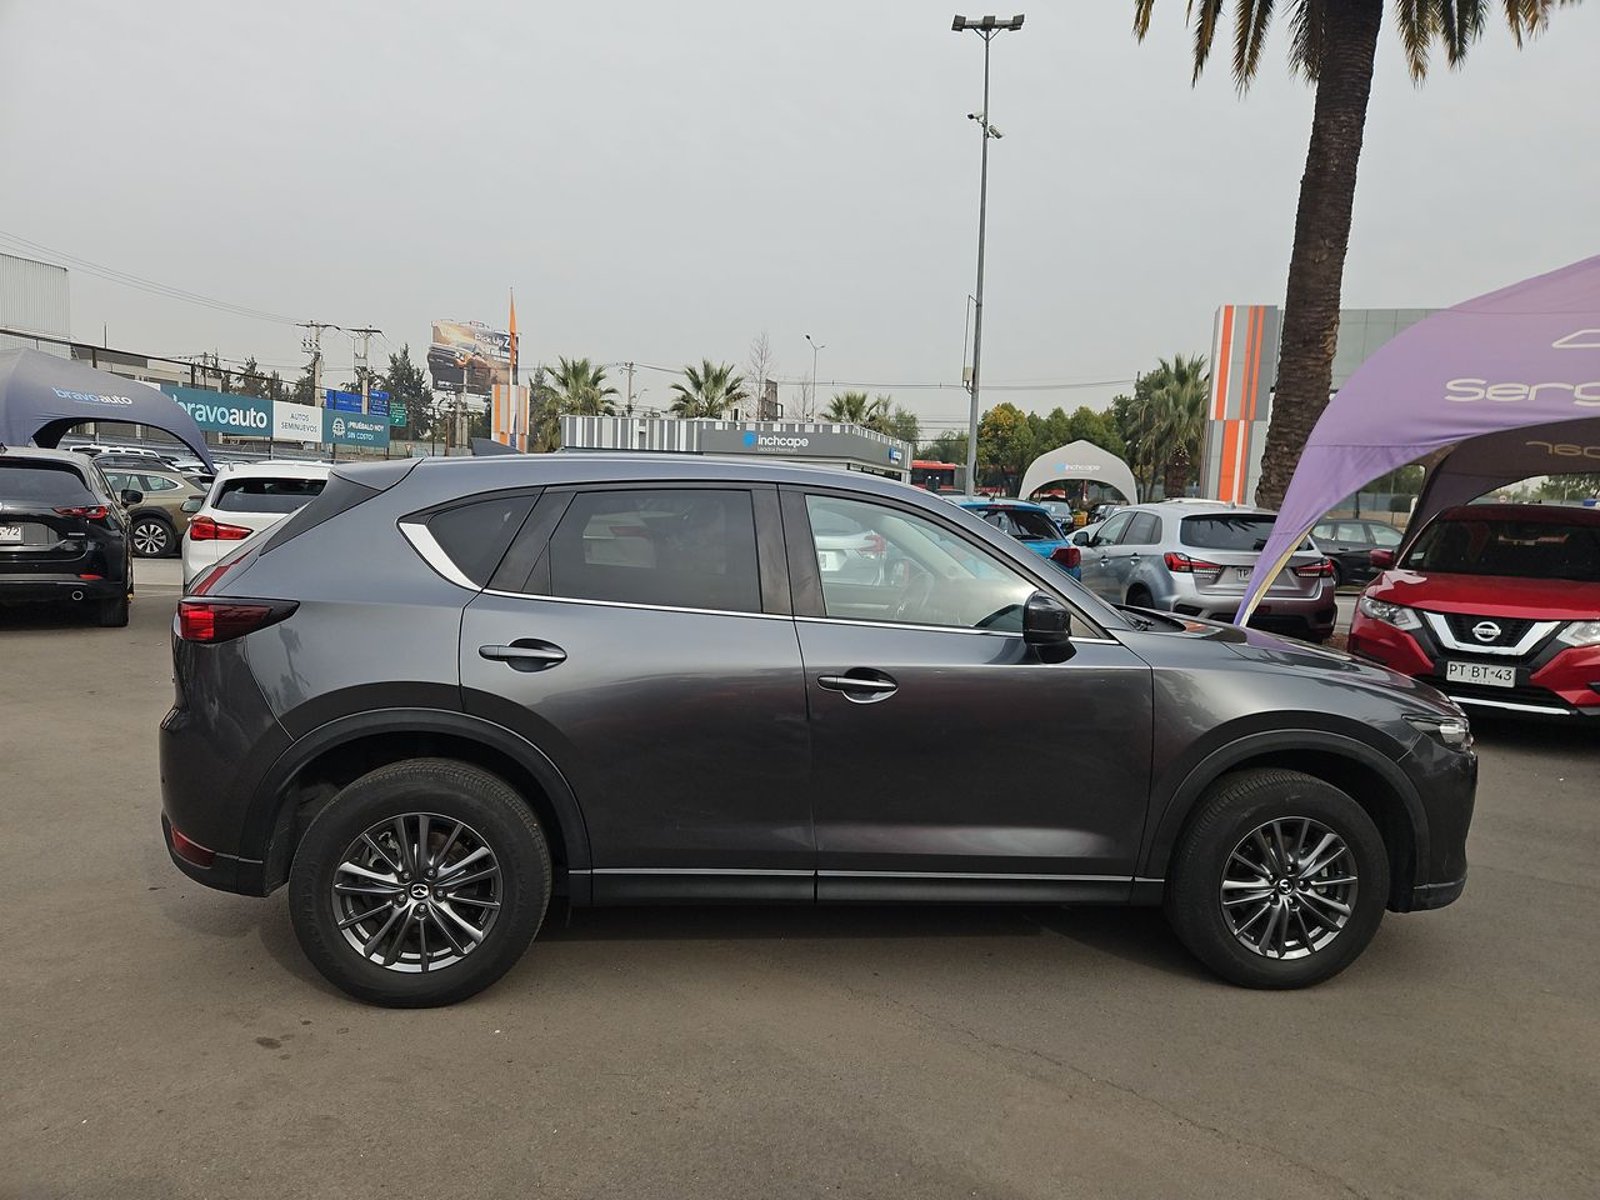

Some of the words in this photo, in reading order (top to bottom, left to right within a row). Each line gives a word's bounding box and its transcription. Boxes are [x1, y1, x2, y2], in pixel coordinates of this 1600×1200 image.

[52, 386, 133, 405] bravoauto
[280, 421, 317, 433] SEMINUEVOS
[758, 434, 809, 449] inchcape
